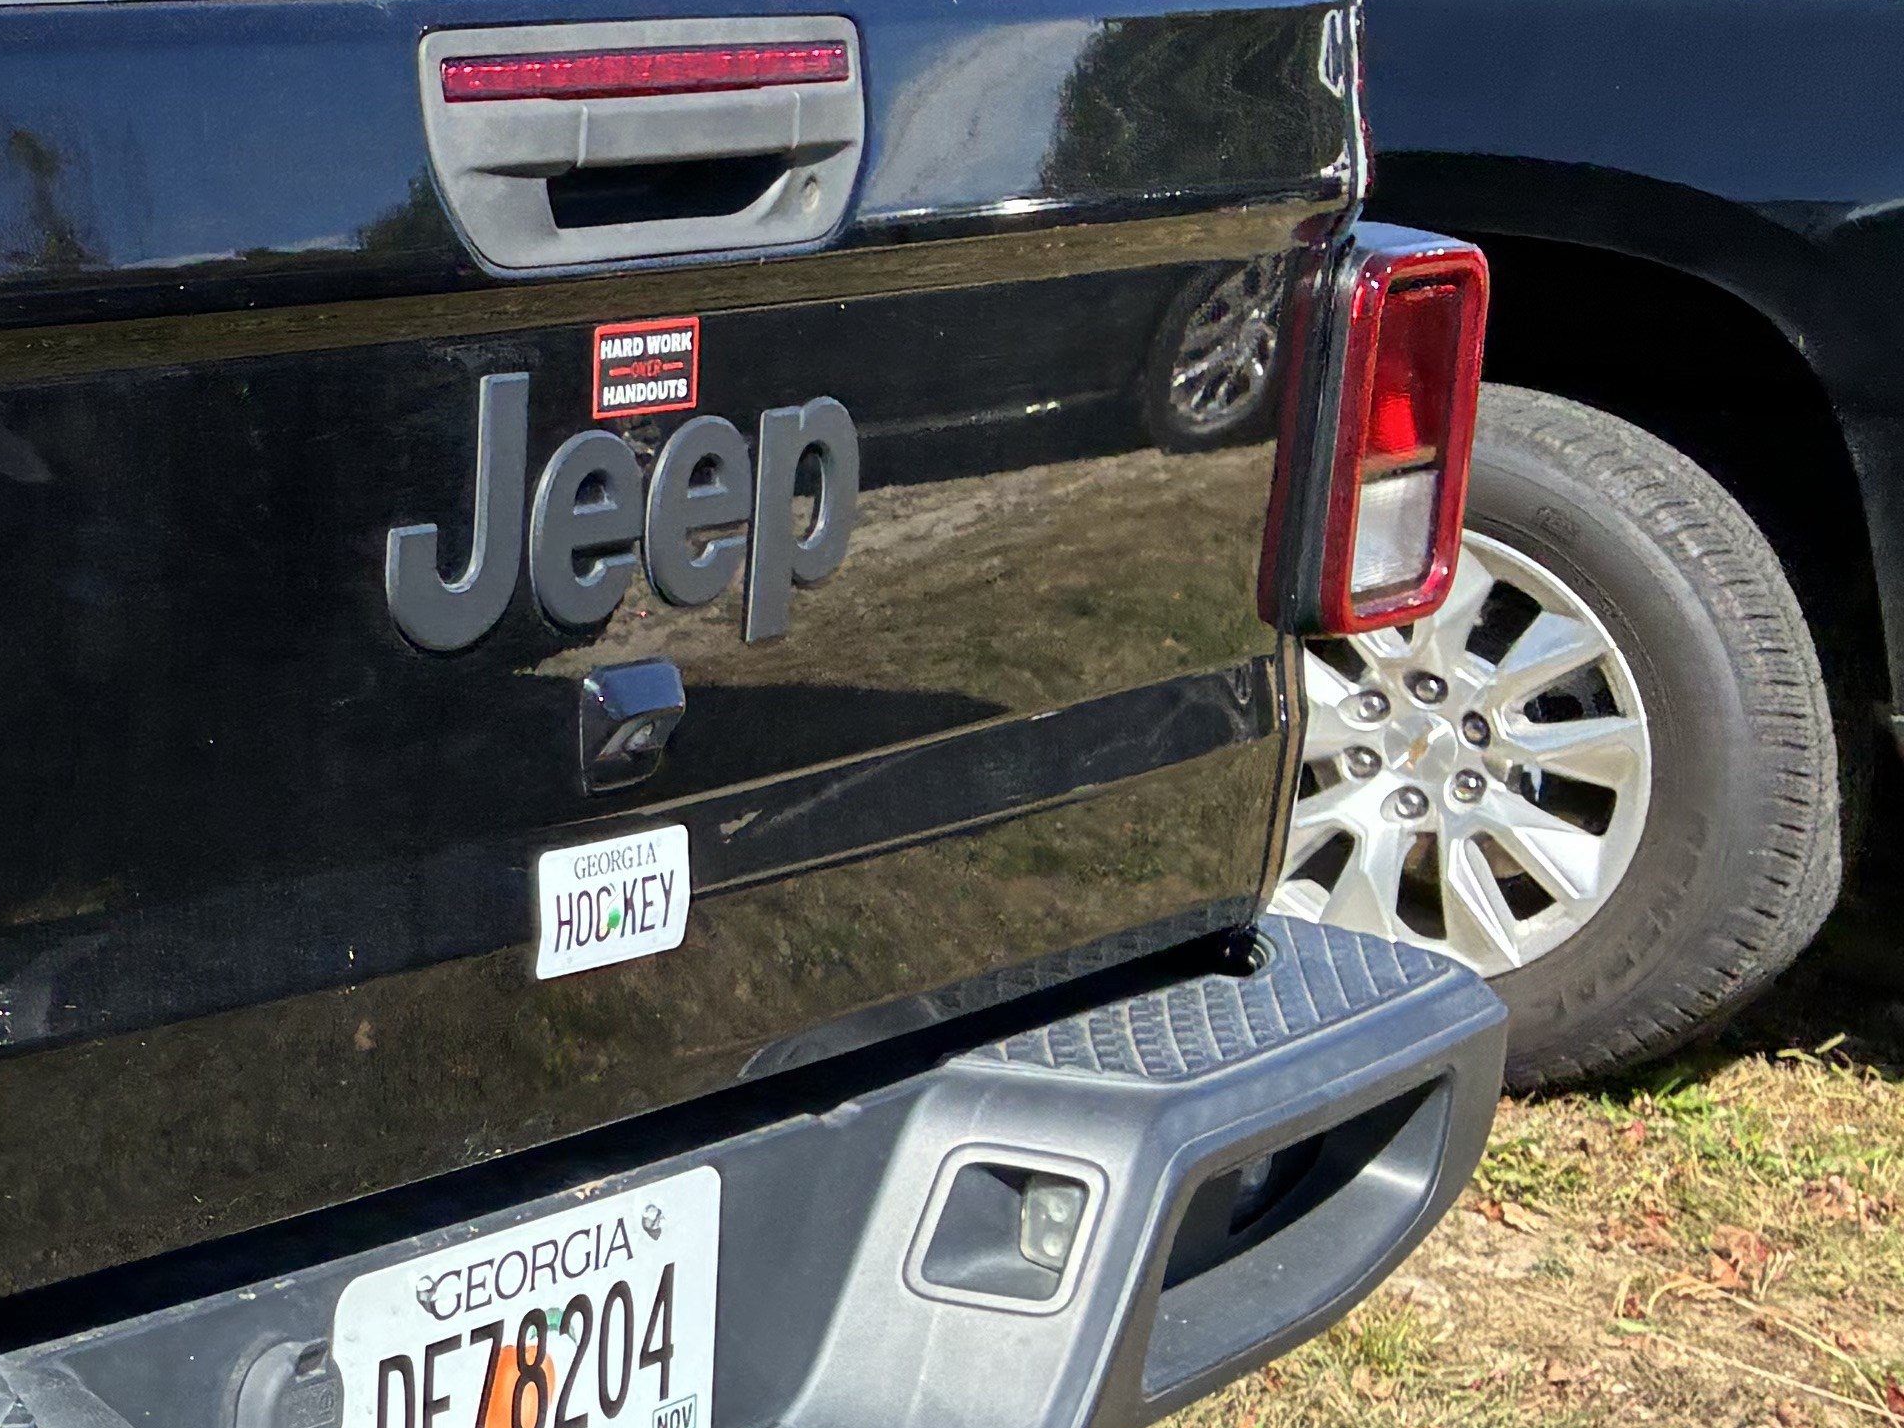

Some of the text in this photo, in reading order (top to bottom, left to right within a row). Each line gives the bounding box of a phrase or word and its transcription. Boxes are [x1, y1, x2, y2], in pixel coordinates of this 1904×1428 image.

[600, 331, 693, 360] HARD WORK
[602, 378, 688, 407] HANDOUTS
[384, 371, 860, 654] Jeep
[574, 841, 658, 880] GEORGIA
[554, 869, 675, 953] HOCKEY
[431, 1218, 634, 1321] GEORGIA
